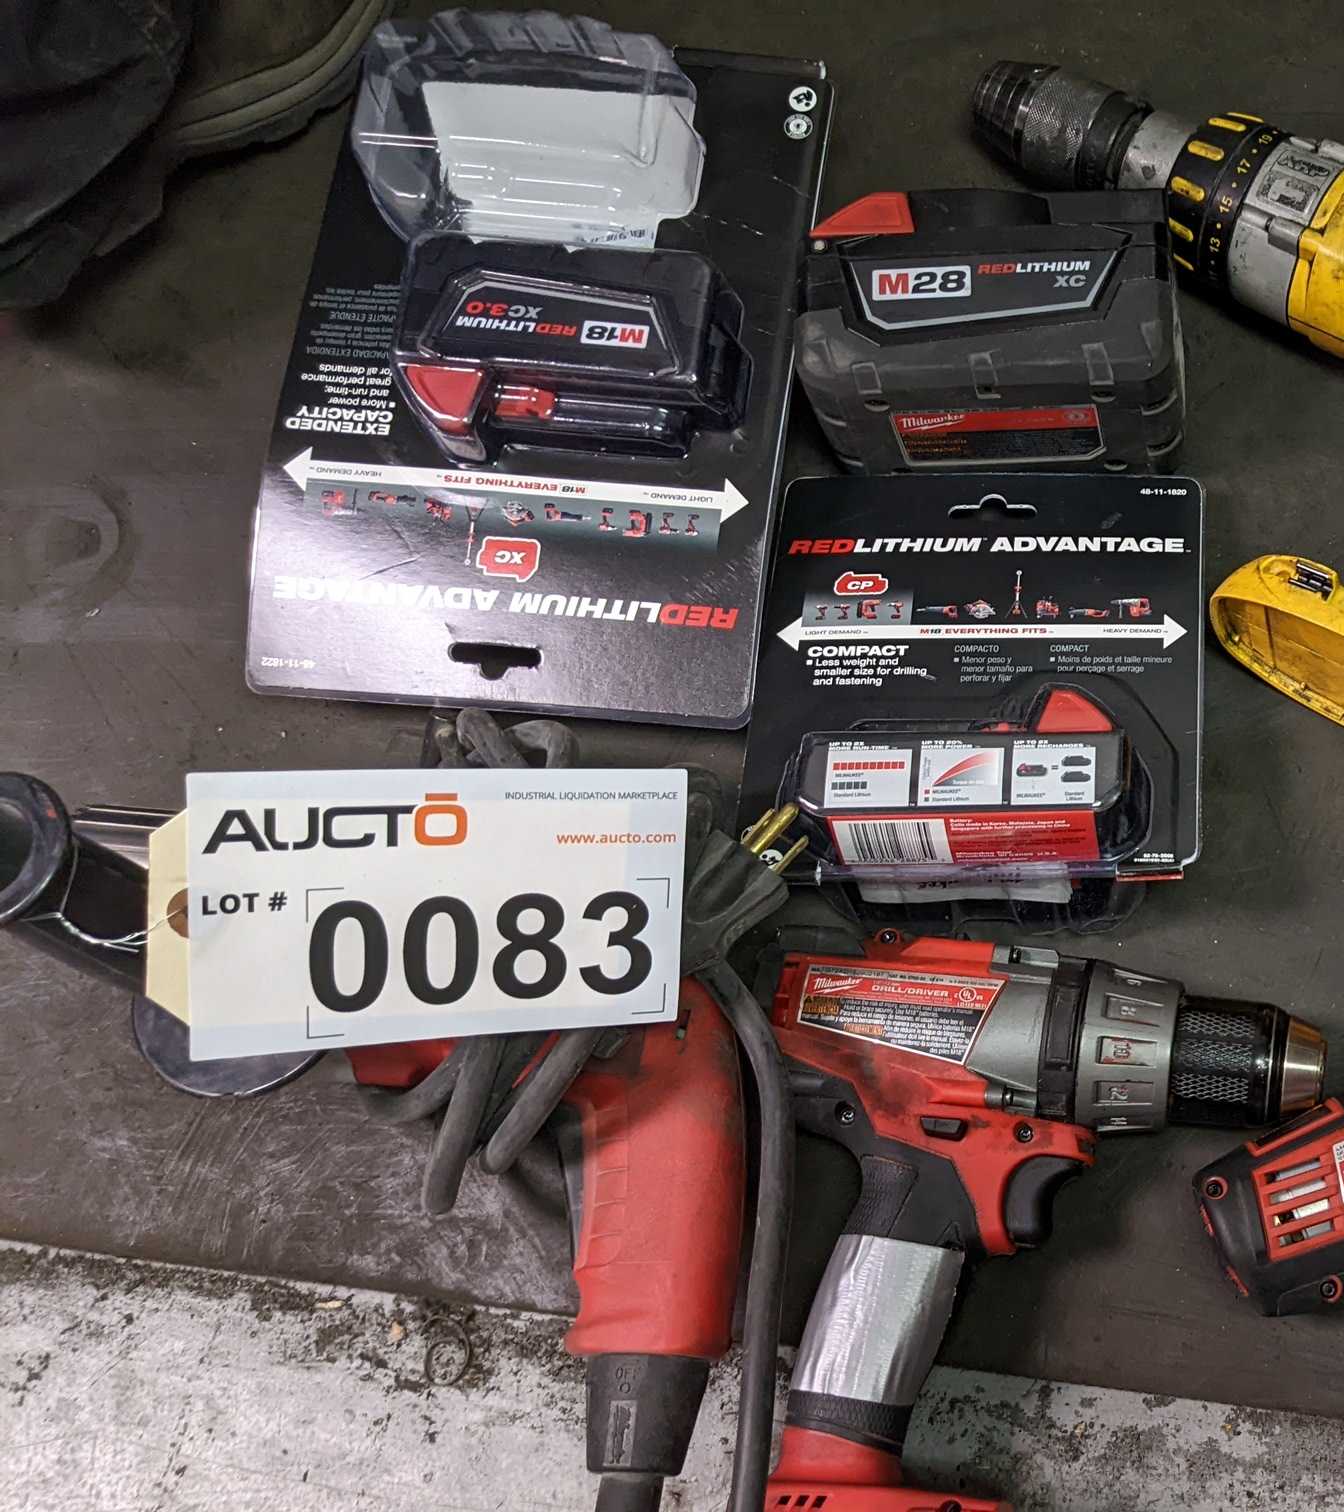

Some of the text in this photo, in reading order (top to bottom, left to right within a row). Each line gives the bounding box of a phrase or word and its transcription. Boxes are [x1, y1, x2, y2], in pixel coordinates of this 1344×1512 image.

[1259, 135, 1273, 145] 19
[1237, 159, 1250, 174] 17
[1220, 196, 1233, 213] 15
[1210, 237, 1221, 252] 13
[878, 260, 1091, 295] M28 REDLITHIUM
[1054, 275, 1086, 288] XC
[455, 314, 645, 344] M18 REDLITHIUM
[318, 363, 365, 374] demands
[366, 367, 378, 375] all
[300, 371, 391, 387] great performance
[369, 388, 389, 397] and
[327, 395, 386, 408] More power
[296, 406, 393, 422] CAPACITY
[285, 417, 390, 435] EXTENDED
[903, 413, 965, 428] Milwaukee
[315, 466, 381, 477] HEAVY DEMAND
[442, 474, 585, 494] M18 EVERYTHING FITS
[650, 492, 686, 500] DEMAND
[990, 535, 1184, 554] ADVANTAGE
[493, 549, 526, 565] XC
[847, 581, 874, 590] CP
[273, 576, 738, 628] REDLITHIUM ADVANTAGE
[808, 645, 909, 657] COMPACT
[954, 645, 999, 653] COMPACTO
[816, 657, 899, 669] Less weight and
[987, 657, 1005, 665] peso
[1007, 657, 1012, 665] y
[1093, 656, 1113, 664] poids
[1124, 655, 1141, 663] taille
[814, 666, 927, 677] smaller size for drilling
[987, 664, 1014, 672] tamaño
[1016, 665, 1033, 674] para
[1076, 665, 1106, 674] perçage
[1117, 665, 1144, 673] serrage
[813, 677, 882, 687] and fastening
[960, 674, 1012, 683] perforar y fijar
[505, 791, 678, 801] INDUSTRIAL LIQUIDATION MARKETPLACE
[556, 832, 676, 846] www.aucto.com
[202, 891, 288, 915] LOT #
[309, 891, 652, 1012] 0083
[814, 977, 862, 993] Milwaukee
[872, 985, 948, 997] DRILL/DRIVER
[1121, 1005, 1136, 1016] 8
